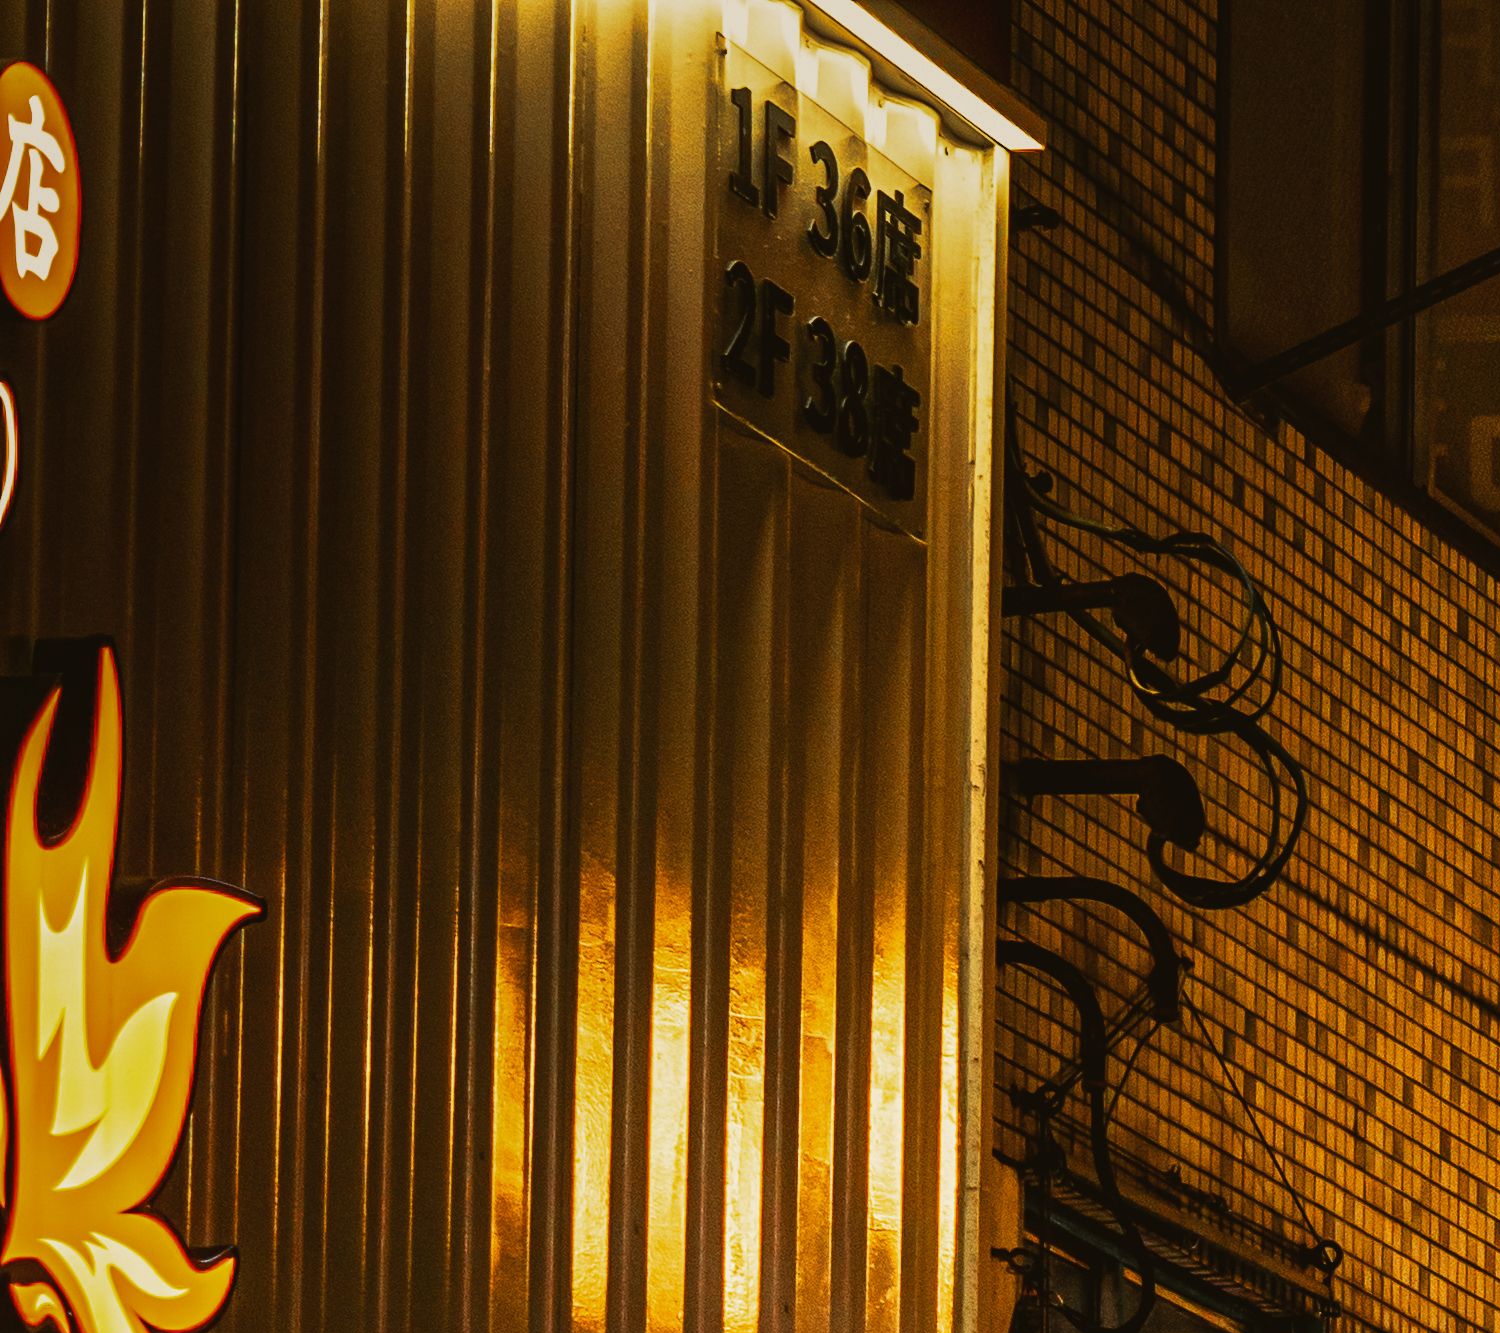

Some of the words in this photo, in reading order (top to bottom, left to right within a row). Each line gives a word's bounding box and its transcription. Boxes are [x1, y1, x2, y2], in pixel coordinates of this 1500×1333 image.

[0, 96, 65, 281] 店
[729, 86, 797, 219] 1F
[807, 139, 923, 326] 36席
[721, 260, 795, 397] 2F
[805, 315, 920, 501] 38席
